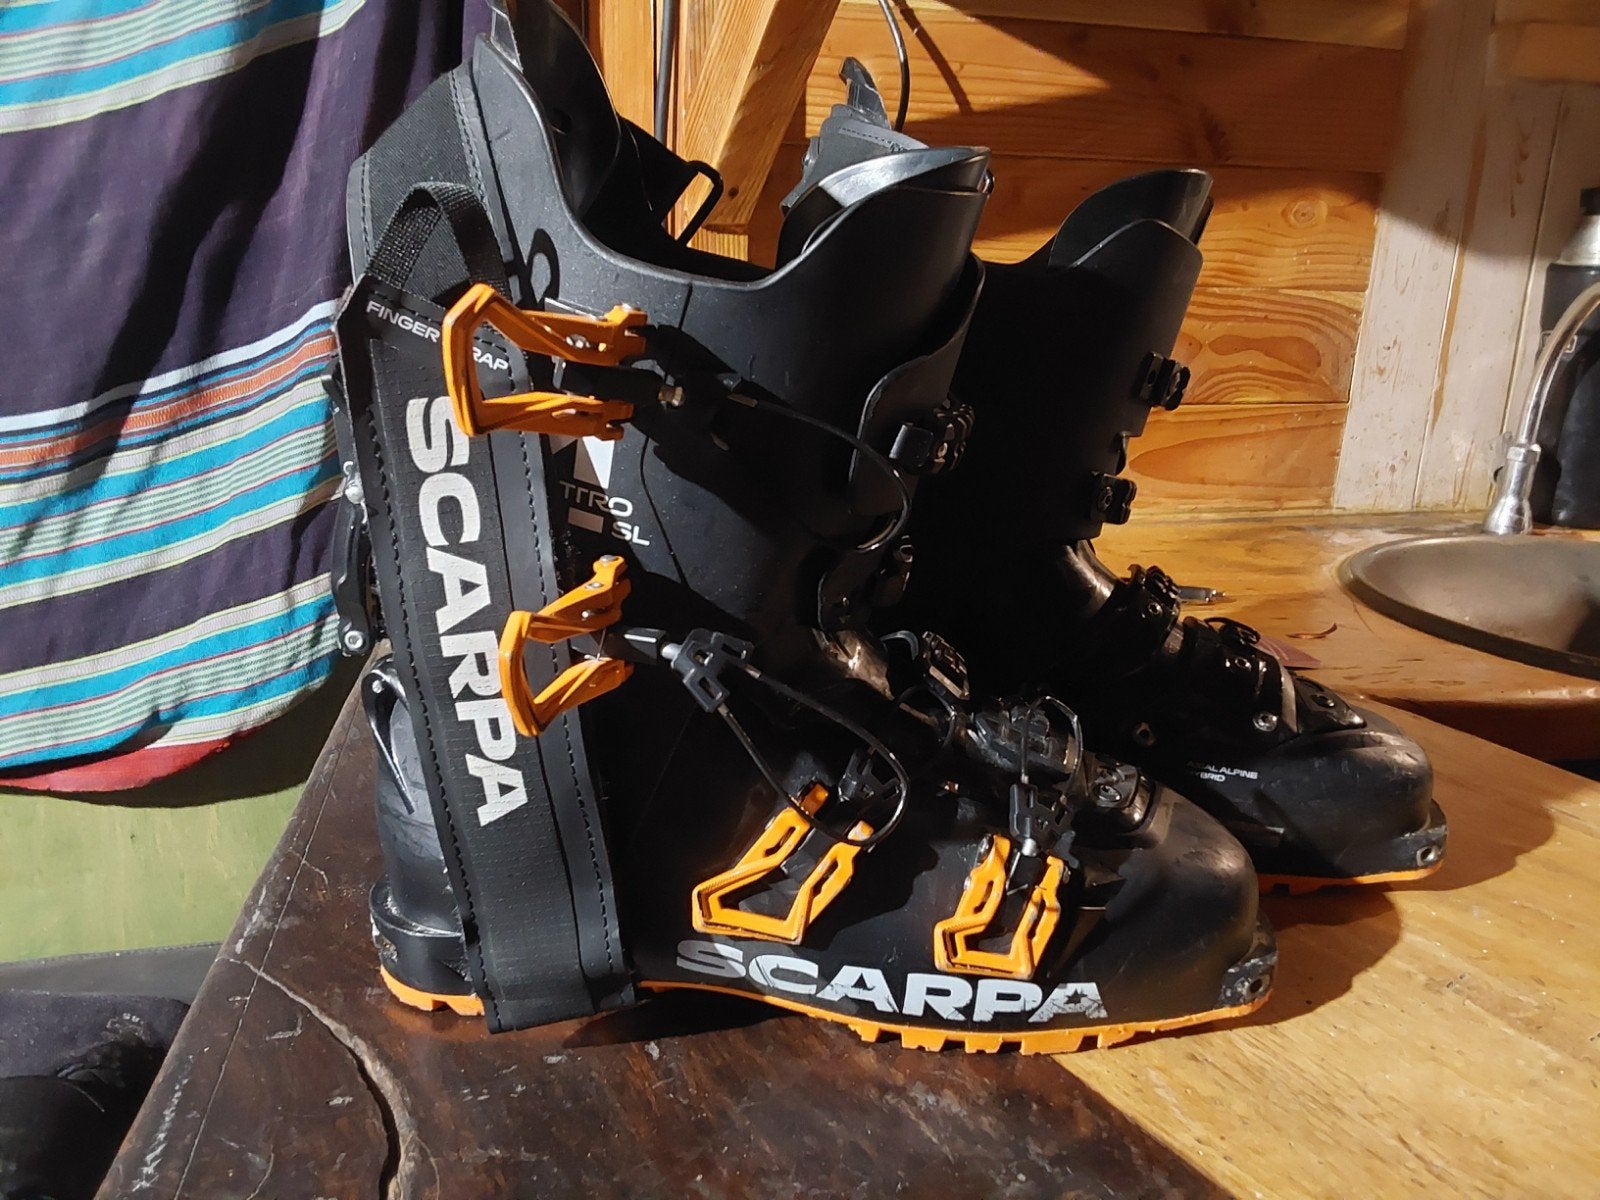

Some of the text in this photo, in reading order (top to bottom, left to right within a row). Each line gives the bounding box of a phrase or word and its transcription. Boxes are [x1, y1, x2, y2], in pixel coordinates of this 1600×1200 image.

[366, 300, 509, 371] FINGER RAP
[610, 521, 650, 547] SL
[405, 396, 528, 828] SCARPA
[1219, 766, 1259, 780] ALPINE
[676, 939, 1108, 1024] SCARPA
